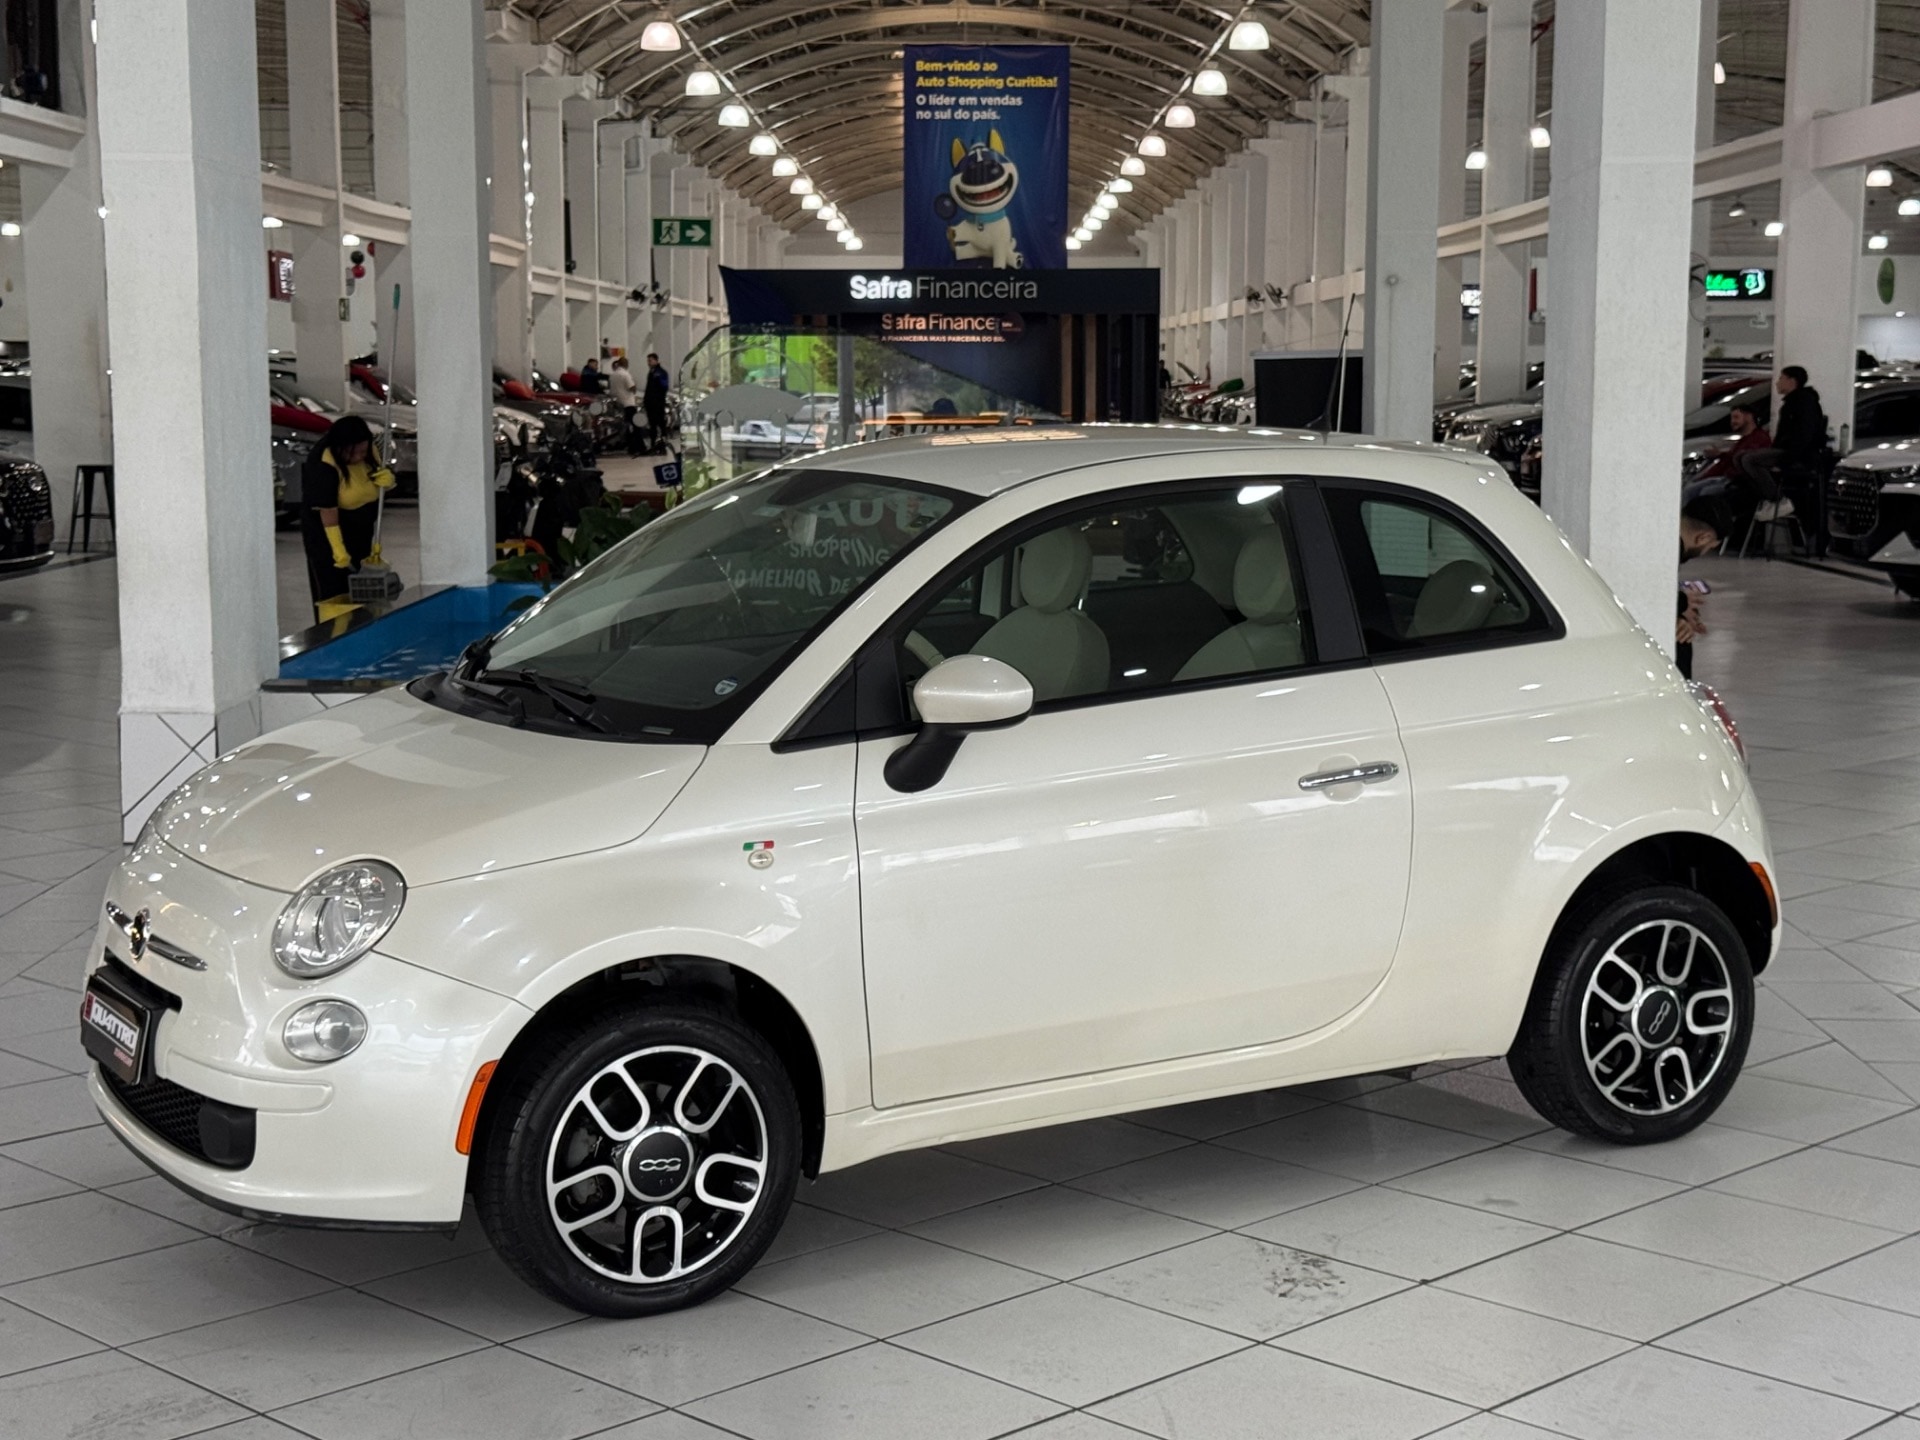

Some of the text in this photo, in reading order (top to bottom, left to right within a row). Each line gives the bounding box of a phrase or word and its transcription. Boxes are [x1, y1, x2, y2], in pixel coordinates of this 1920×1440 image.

[915, 60, 998, 72] Bem-vindo ao
[915, 76, 1058, 89] Auto Shopping Curitiba!
[915, 94, 1023, 106] O líder em vendas
[915, 108, 1001, 121] no sul do país.
[849, 274, 1039, 300] Safra Financeira
[881, 313, 927, 330] Safra
[929, 313, 996, 330] Finance
